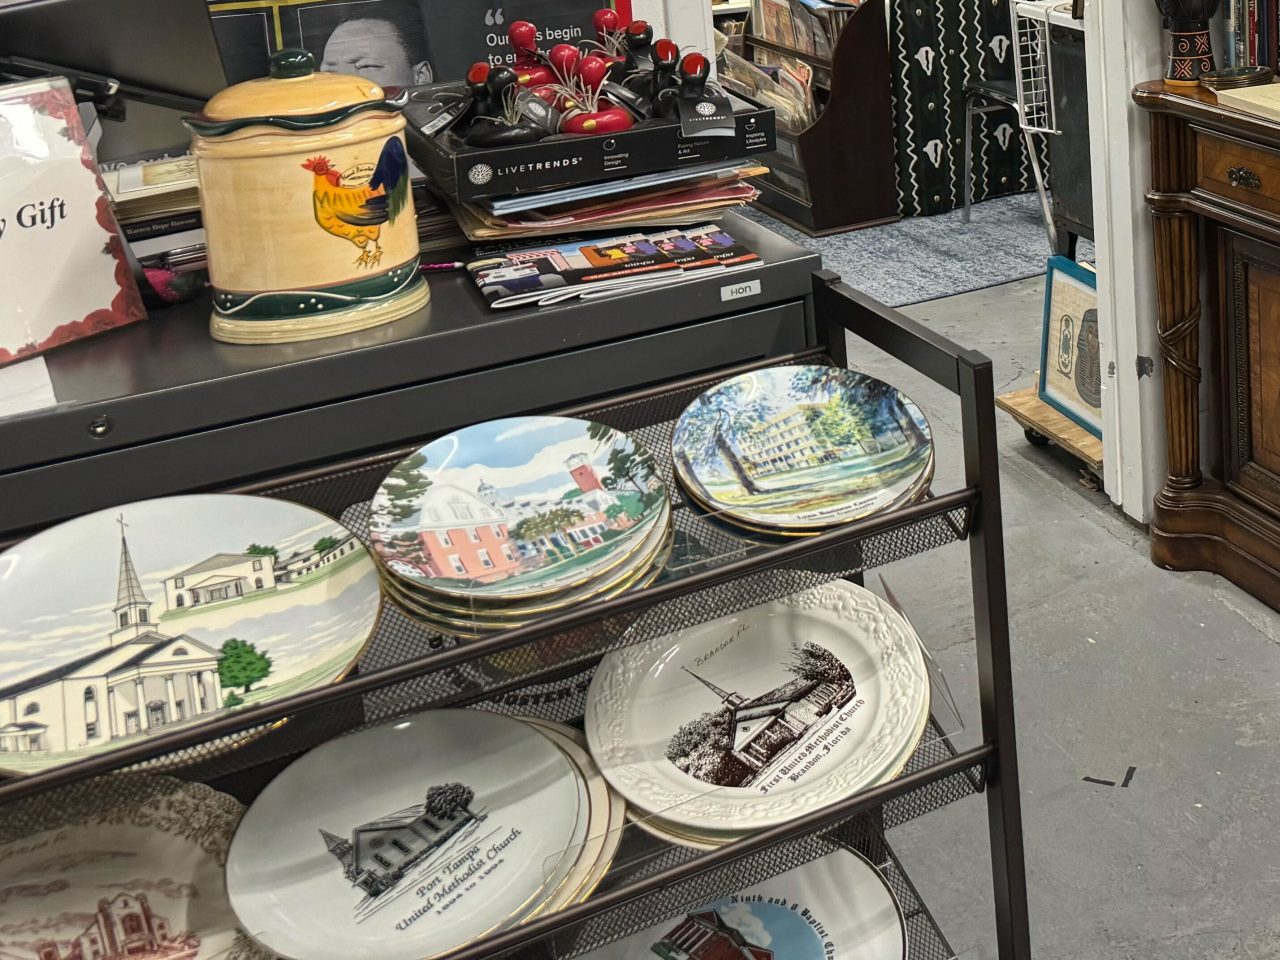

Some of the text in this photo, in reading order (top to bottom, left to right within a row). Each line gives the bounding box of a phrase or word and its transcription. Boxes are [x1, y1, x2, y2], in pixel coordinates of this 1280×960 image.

[16, 197, 67, 230] Gift
[759, 697, 866, 795] First United Methodist Church
[788, 725, 853, 784] Brandon, Florida
[395, 897, 434, 930] United
[434, 859, 486, 902] Methodist
[486, 828, 522, 860] Church
[416, 876, 442, 897] Port
[442, 845, 481, 875] Tampa
[801, 908, 829, 938] Baptist
